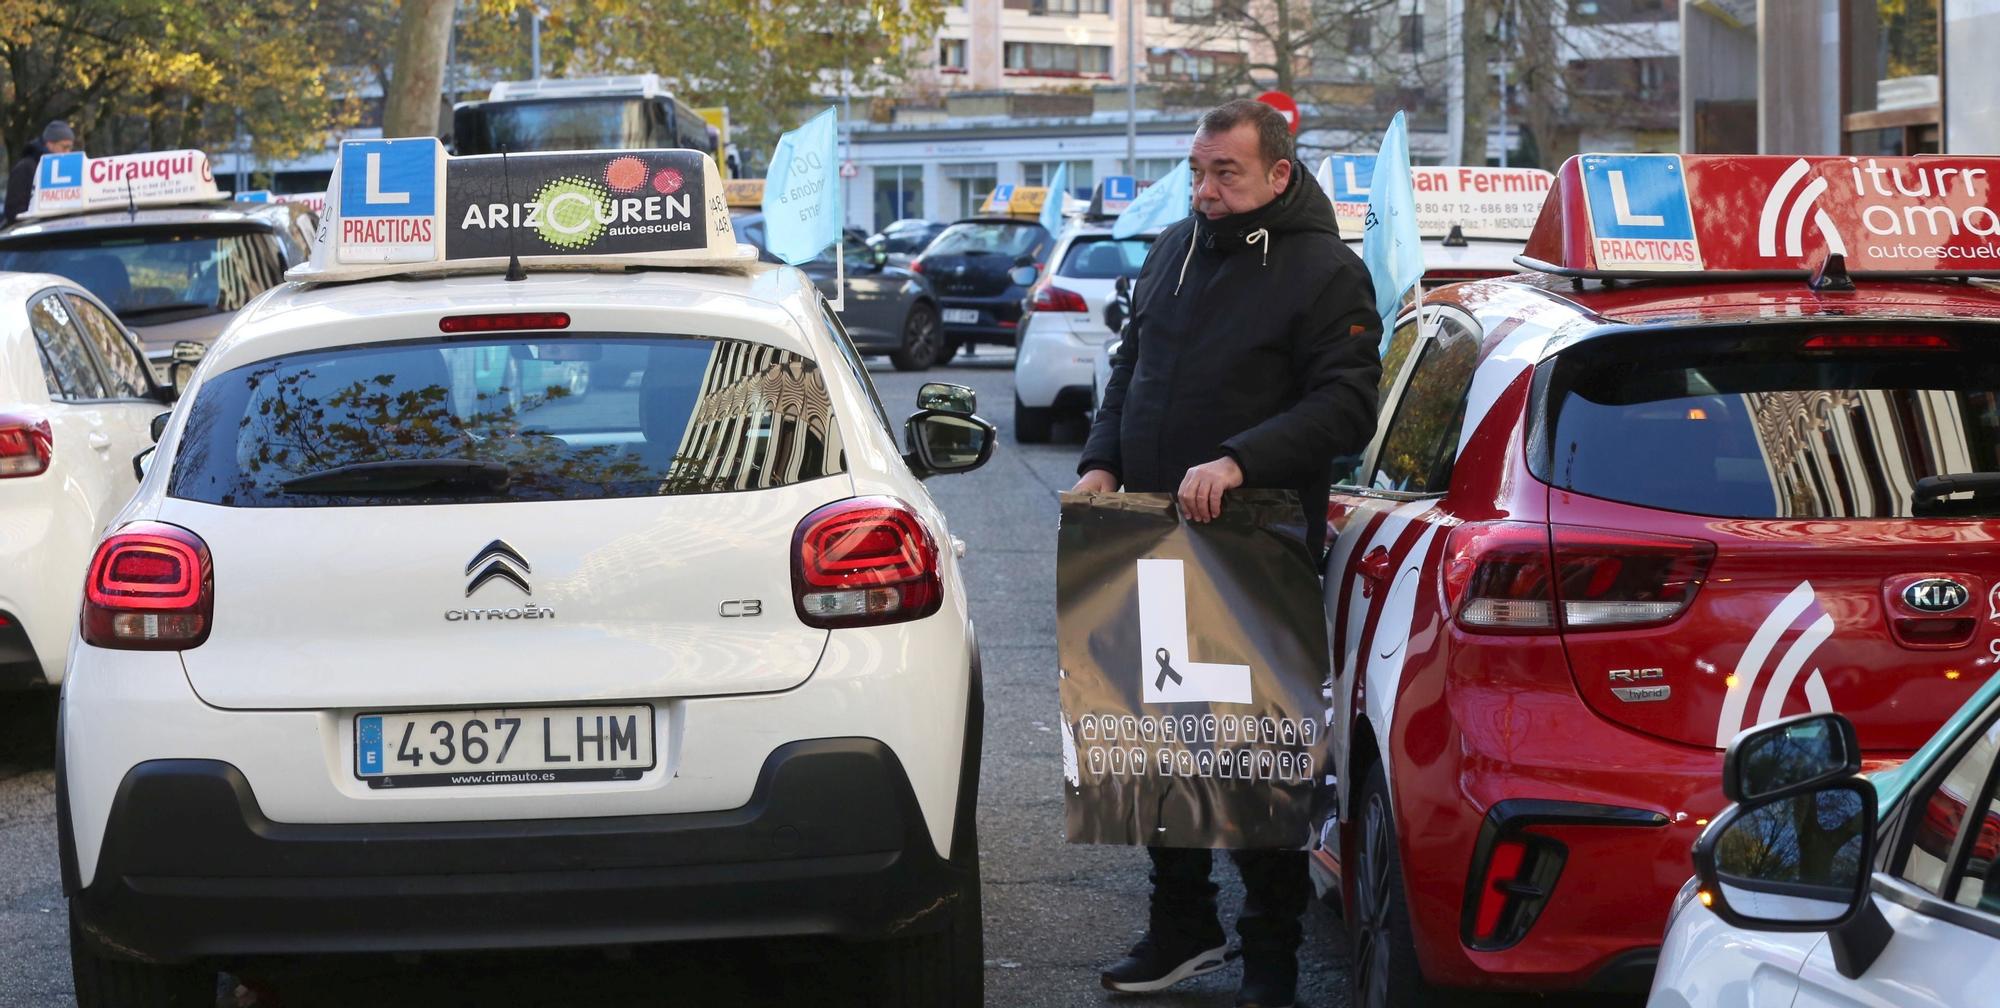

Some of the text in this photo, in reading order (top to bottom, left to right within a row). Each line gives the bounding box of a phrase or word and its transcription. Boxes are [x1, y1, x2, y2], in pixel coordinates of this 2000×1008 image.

[51, 159, 72, 185] L
[89, 152, 194, 184] Cirauqui
[366, 152, 410, 205] L
[1344, 161, 1371, 195] L
[1849, 156, 1986, 197] iturr
[40, 187, 81, 201] PRACTICAS
[1111, 179, 1127, 198] L
[1608, 171, 1664, 226] L
[461, 192, 691, 234] ARIZCUREN
[1425, 203, 1438, 213] 80
[1442, 203, 1454, 213] 47
[1459, 203, 1470, 213] 12
[1505, 203, 1518, 213] 89
[1523, 203, 1534, 213] 12
[343, 219, 431, 243] PRACTICAS
[609, 221, 691, 237] autoescuela
[1862, 205, 2000, 236] ama
[1600, 240, 1694, 261] PRACTICAS
[718, 599, 762, 617] C3
[1914, 586, 1962, 607] KIA
[444, 602, 555, 621] CITROËN
[1137, 559, 1252, 704] L
[1609, 667, 1663, 681] RIO
[1629, 688, 1663, 699] hybrid
[1082, 716, 1313, 739] AUTOESCUELAS
[366, 715, 638, 767] E 4367 LHM
[1161, 750, 1310, 773] EXAMENES
[451, 772, 556, 785] www.cirmauto.es
